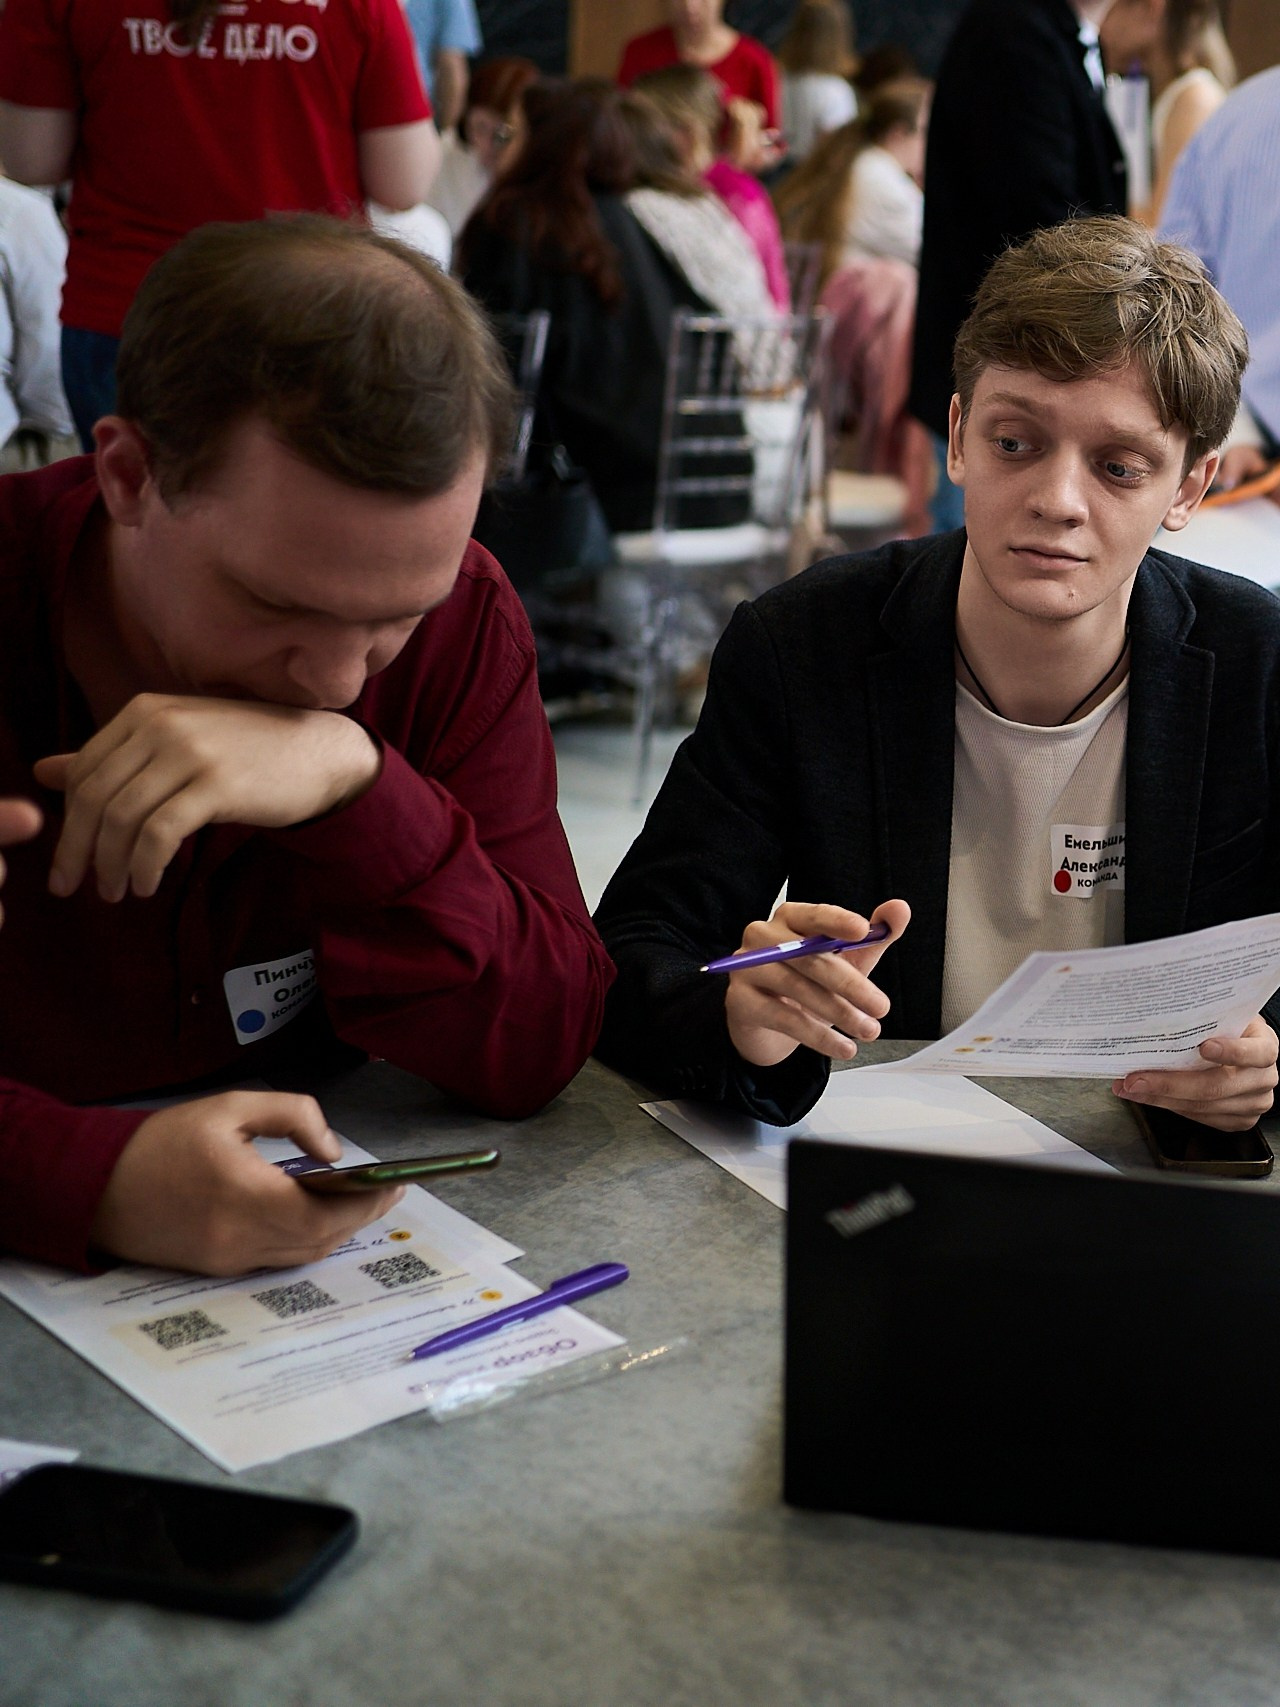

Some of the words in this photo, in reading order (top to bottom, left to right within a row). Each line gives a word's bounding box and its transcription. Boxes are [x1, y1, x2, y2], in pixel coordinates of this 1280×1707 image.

[223, 22, 319, 66] ДЕЛО
[1064, 834, 1126, 850] Емельши
[1060, 856, 1126, 873] Александ
